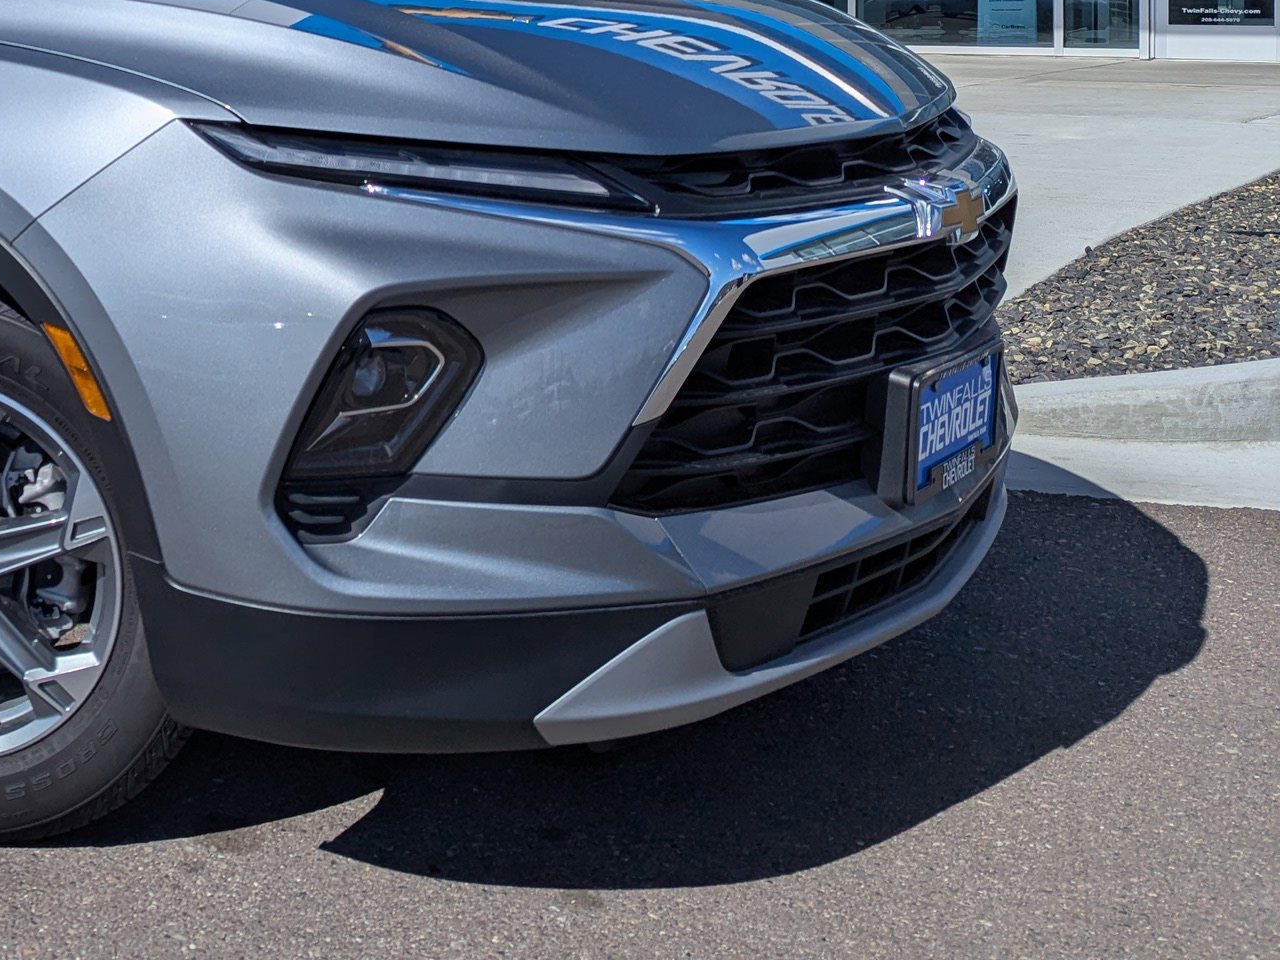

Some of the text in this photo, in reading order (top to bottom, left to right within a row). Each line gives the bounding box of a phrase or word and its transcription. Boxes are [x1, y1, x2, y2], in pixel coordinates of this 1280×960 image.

[918, 389, 992, 462] CHEVROLET
[920, 367, 992, 425] TWINFALLS
[942, 457, 976, 490] CHEVROLET
[5, 718, 119, 800] CROSS
